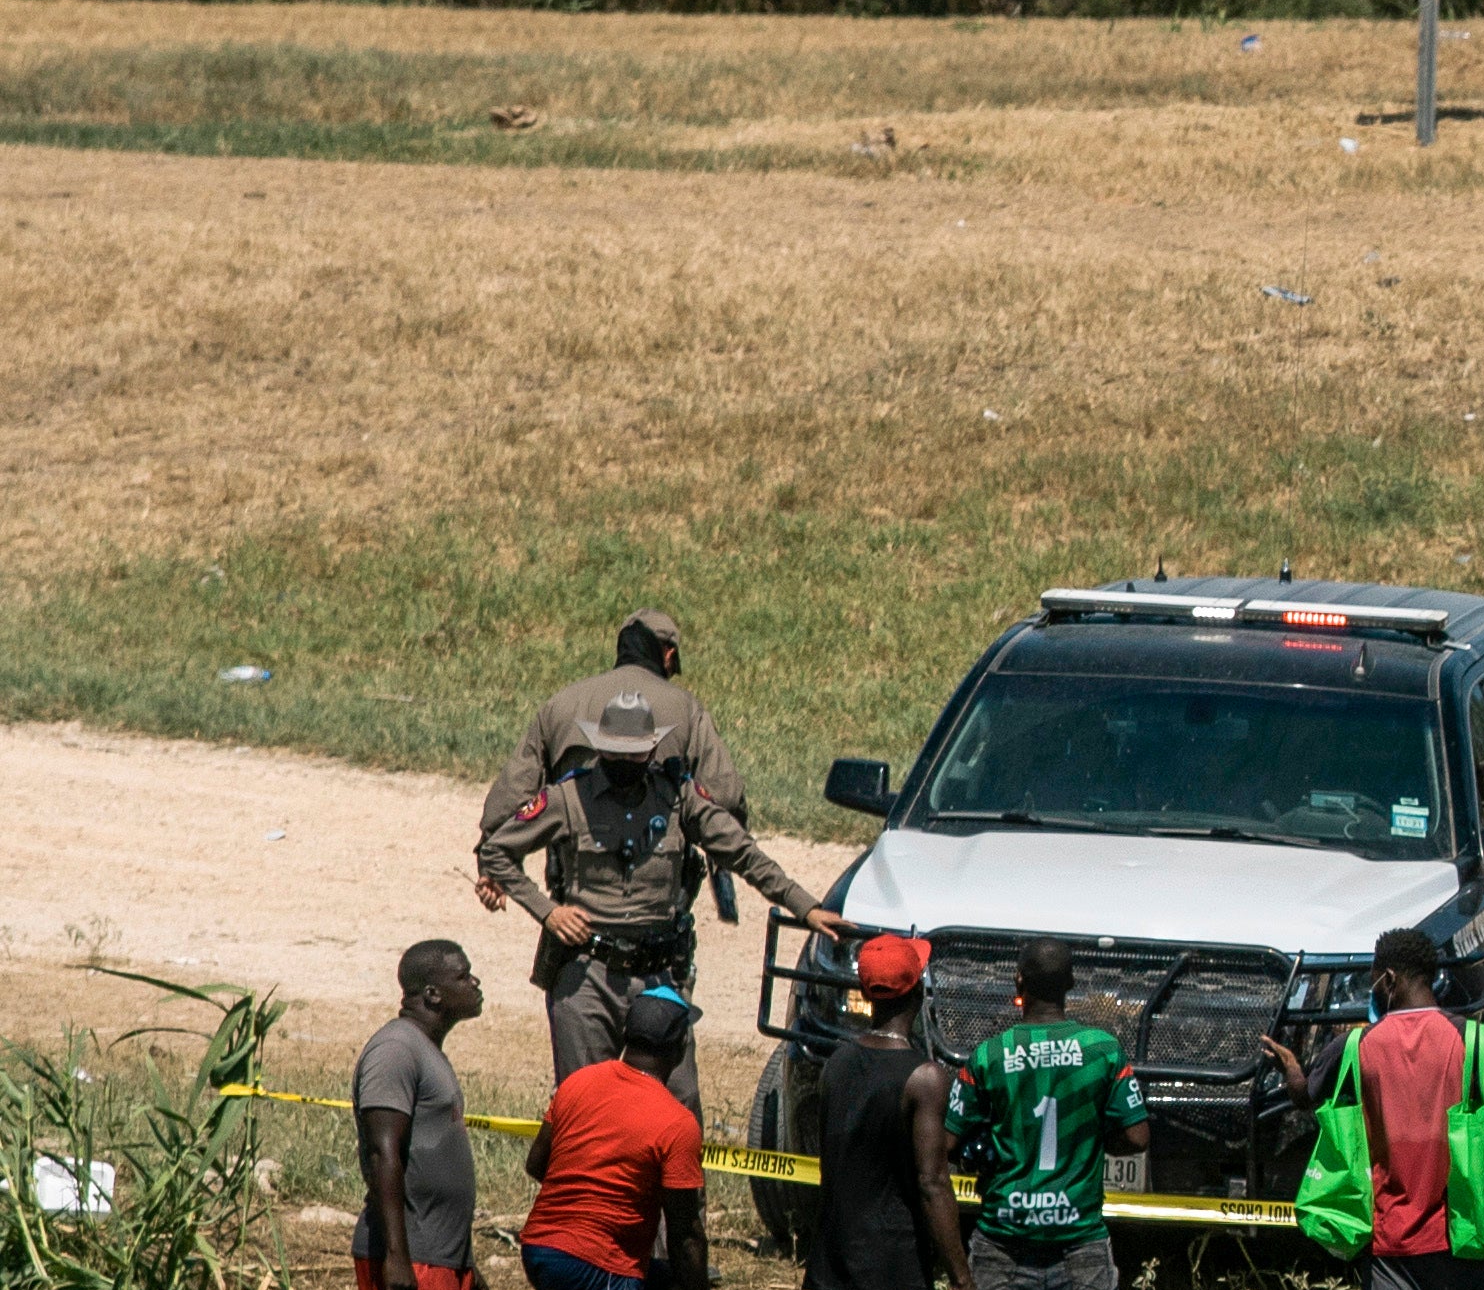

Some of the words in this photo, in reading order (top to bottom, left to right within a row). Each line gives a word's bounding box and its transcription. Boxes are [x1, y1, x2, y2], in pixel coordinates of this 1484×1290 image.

[1004, 1045, 1027, 1060] LA
[1029, 1039, 1082, 1057] SELVA
[1004, 1057, 1025, 1073] ES
[1026, 1052, 1083, 1068] VERDE
[1033, 1095, 1058, 1171] 1
[702, 1144, 728, 1166] LIN
[731, 1149, 796, 1176] SHERIFF'S
[1008, 1191, 1071, 1209] CUIDA
[997, 1208, 1020, 1224] EL
[1024, 1206, 1080, 1226] AGUA
[1220, 1202, 1263, 1220] CROSS
